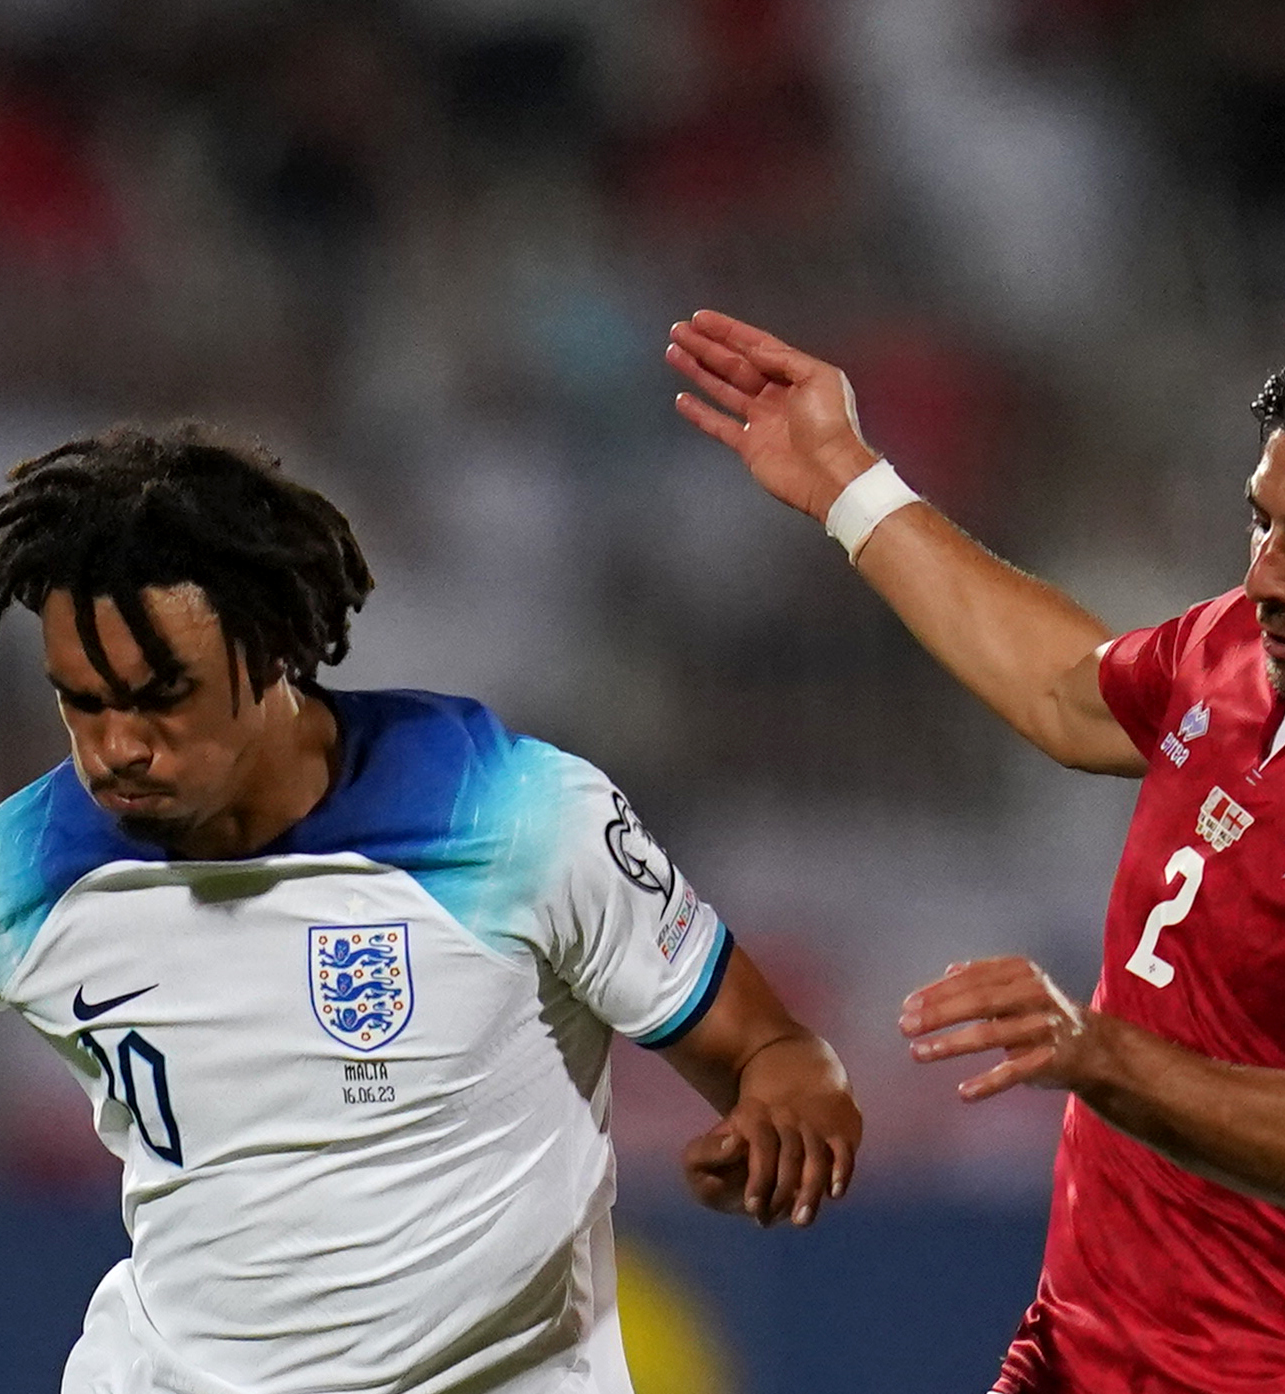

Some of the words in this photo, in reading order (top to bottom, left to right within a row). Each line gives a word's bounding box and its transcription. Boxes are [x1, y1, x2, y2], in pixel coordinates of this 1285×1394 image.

[1160, 731, 1190, 769] errea
[1125, 845, 1205, 989] 2
[344, 1062, 388, 1081] MALTA
[342, 1086, 396, 1105] 16.06.23
